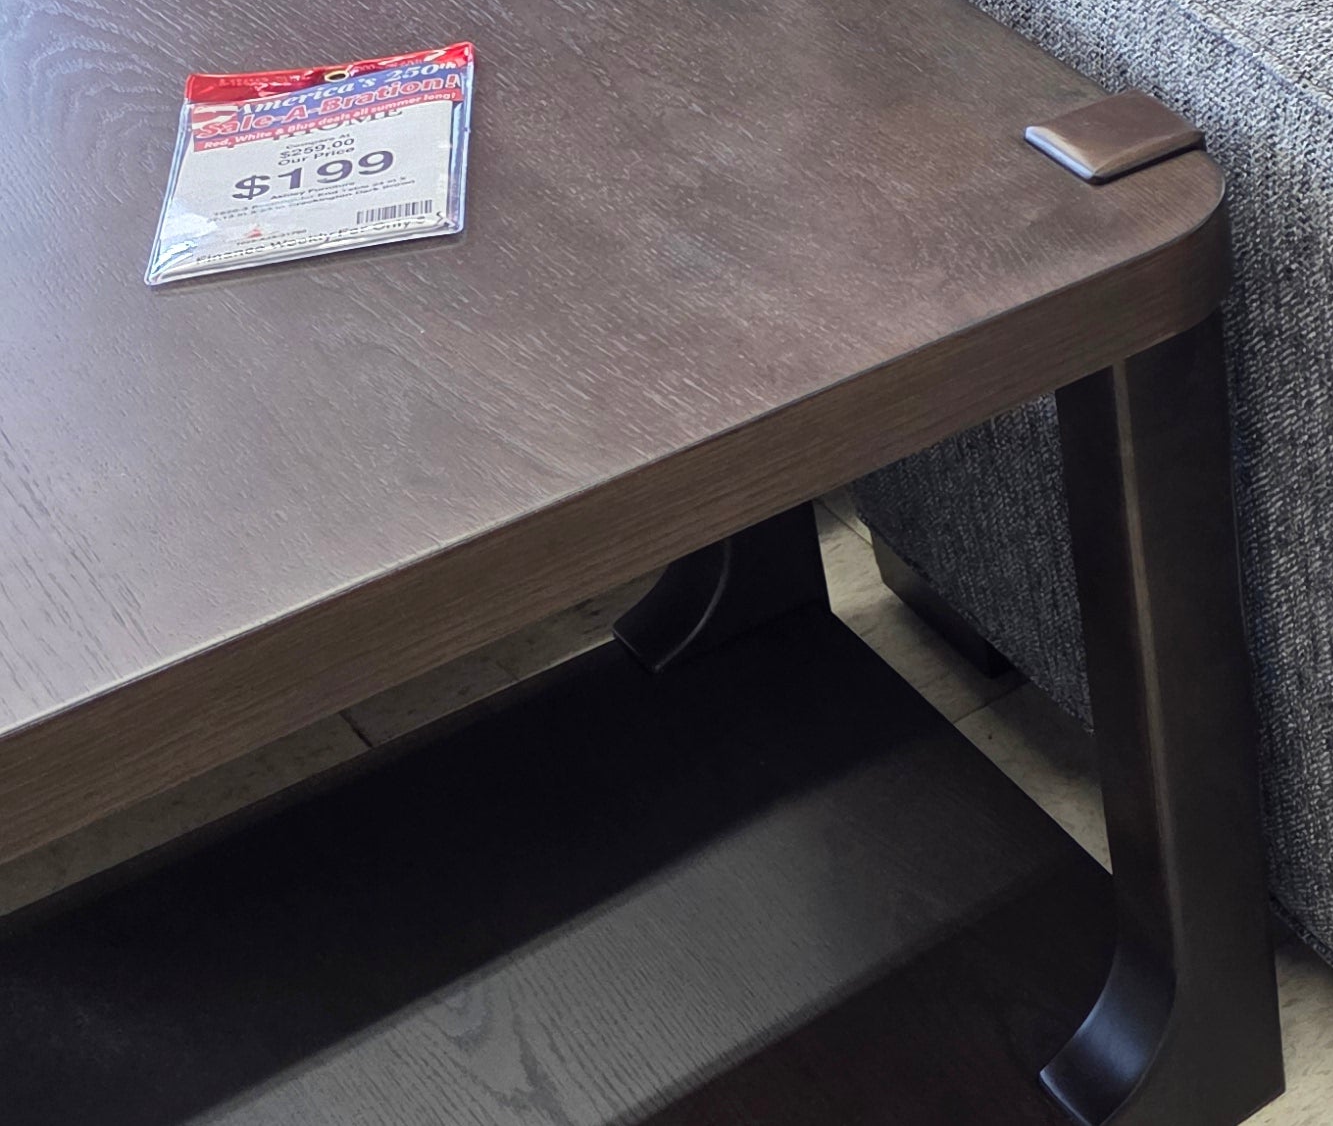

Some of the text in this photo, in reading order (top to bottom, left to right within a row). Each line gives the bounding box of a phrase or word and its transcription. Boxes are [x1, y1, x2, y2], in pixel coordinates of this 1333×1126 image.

[196, 73, 460, 139] Sale-A-Bration!
[240, 61, 457, 115] America's 250th
[204, 91, 457, 149] Red, White & Blue deals all summer long!
[232, 149, 394, 201] $199
[278, 147, 355, 166] Our Price
[279, 138, 355, 160] $259.00
